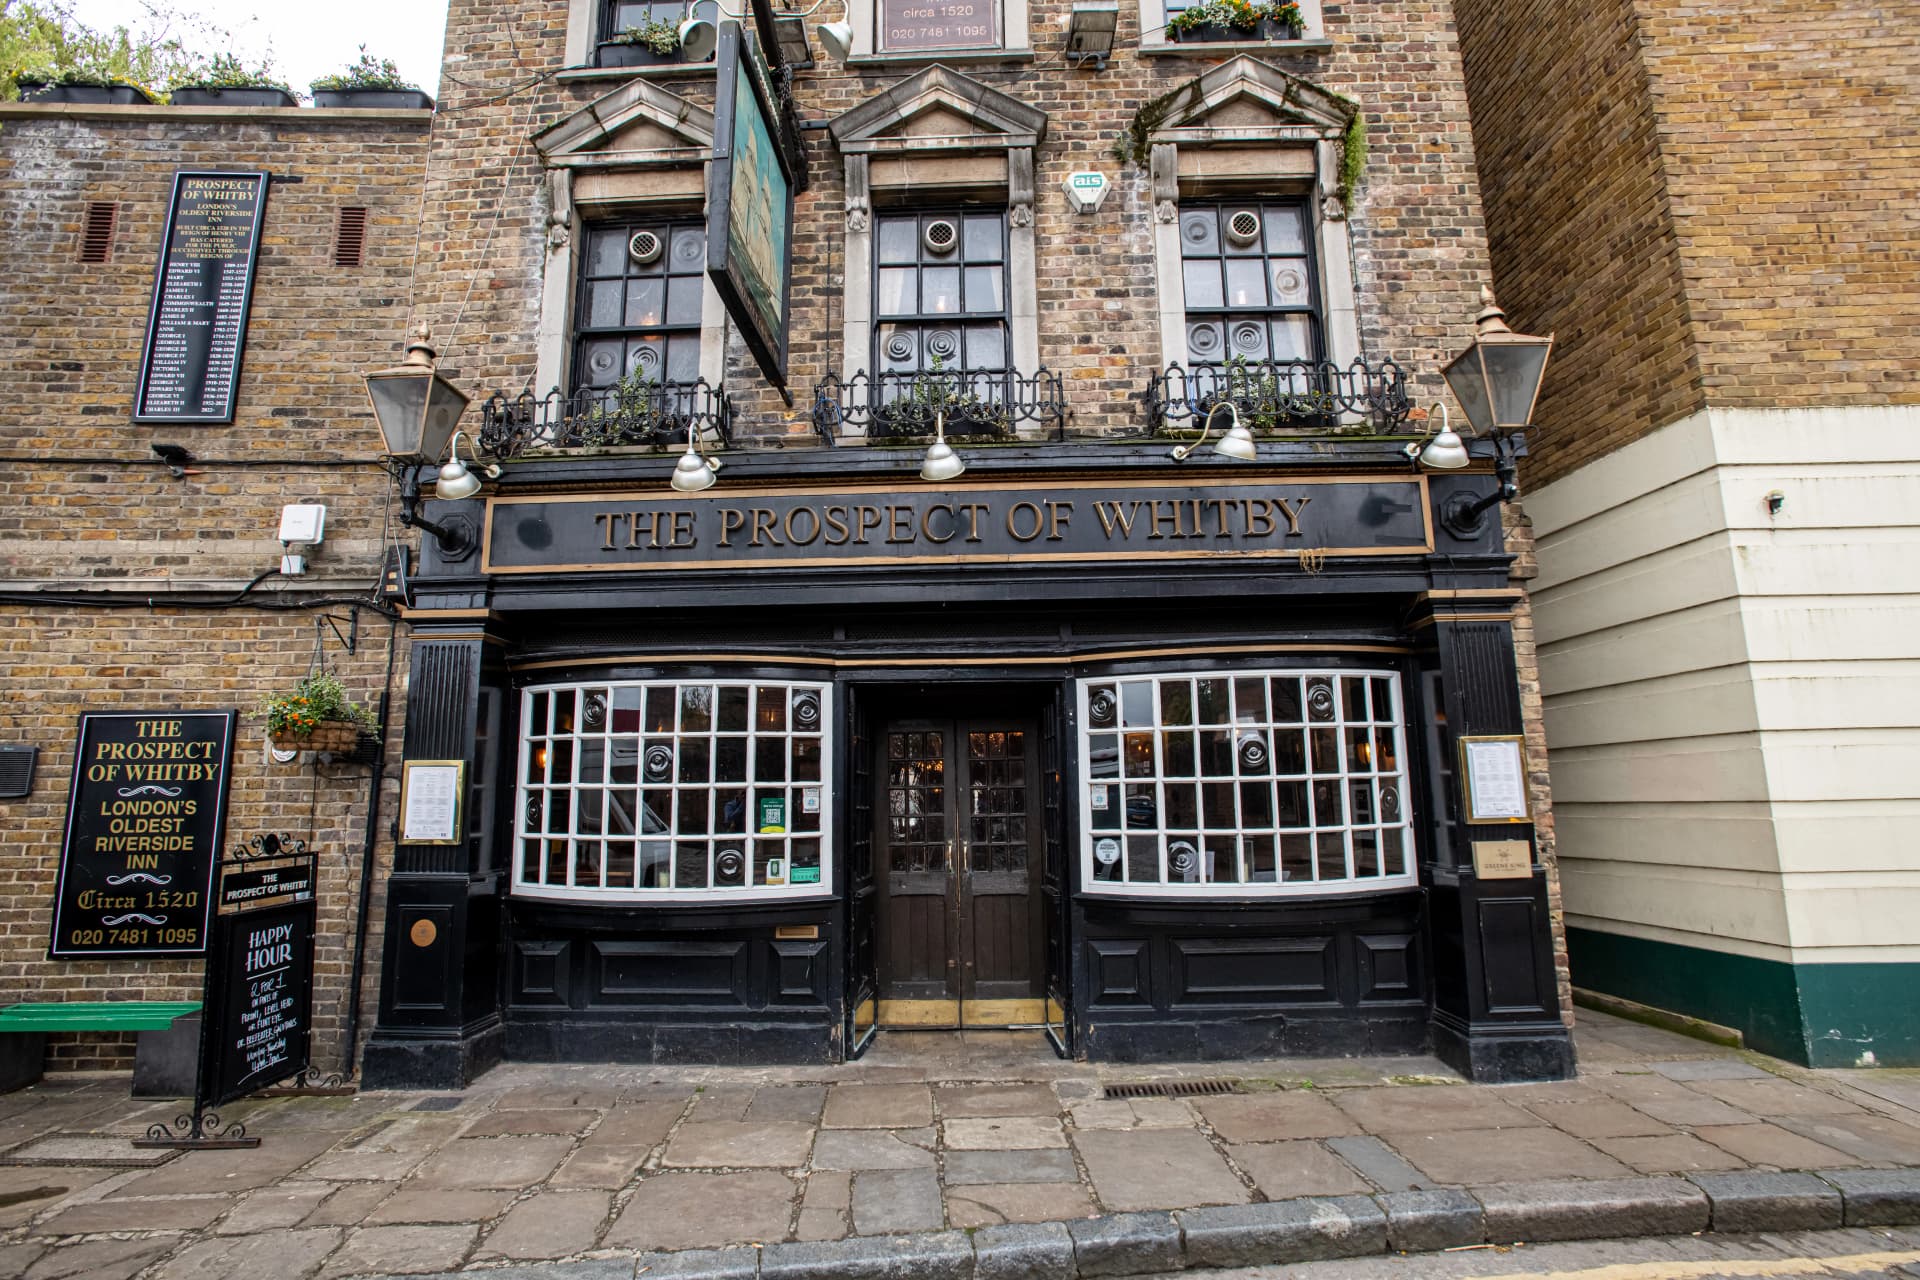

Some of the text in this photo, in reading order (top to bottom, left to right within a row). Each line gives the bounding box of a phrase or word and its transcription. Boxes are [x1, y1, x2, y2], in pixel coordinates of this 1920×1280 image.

[904, 5, 973, 18] circa 1520
[892, 29, 915, 38] 020
[920, 28, 948, 37] 7481
[188, 180, 256, 190] PROSPECT
[183, 190, 256, 200] OF WHITBY
[596, 497, 1312, 550] THE PROSPECT OF WHITBY
[136, 720, 182, 737] THE
[96, 742, 216, 760] PROSPECT
[88, 763, 219, 782] OF WHITBY
[101, 800, 197, 816] LONDON'S
[110, 819, 184, 834] OLDEST
[96, 836, 194, 851] RIVERSIDE
[127, 855, 158, 869] INN
[262, 874, 278, 883] THE
[227, 880, 308, 900] PROSPECT OF WHITBY
[78, 890, 199, 909] Circa 1520
[72, 928, 196, 944] 020 7481 1095
[249, 924, 293, 948] HAPPY
[245, 943, 292, 972] HOUR
[251, 982, 260, 997] 2
[275, 972, 286, 988] 1
